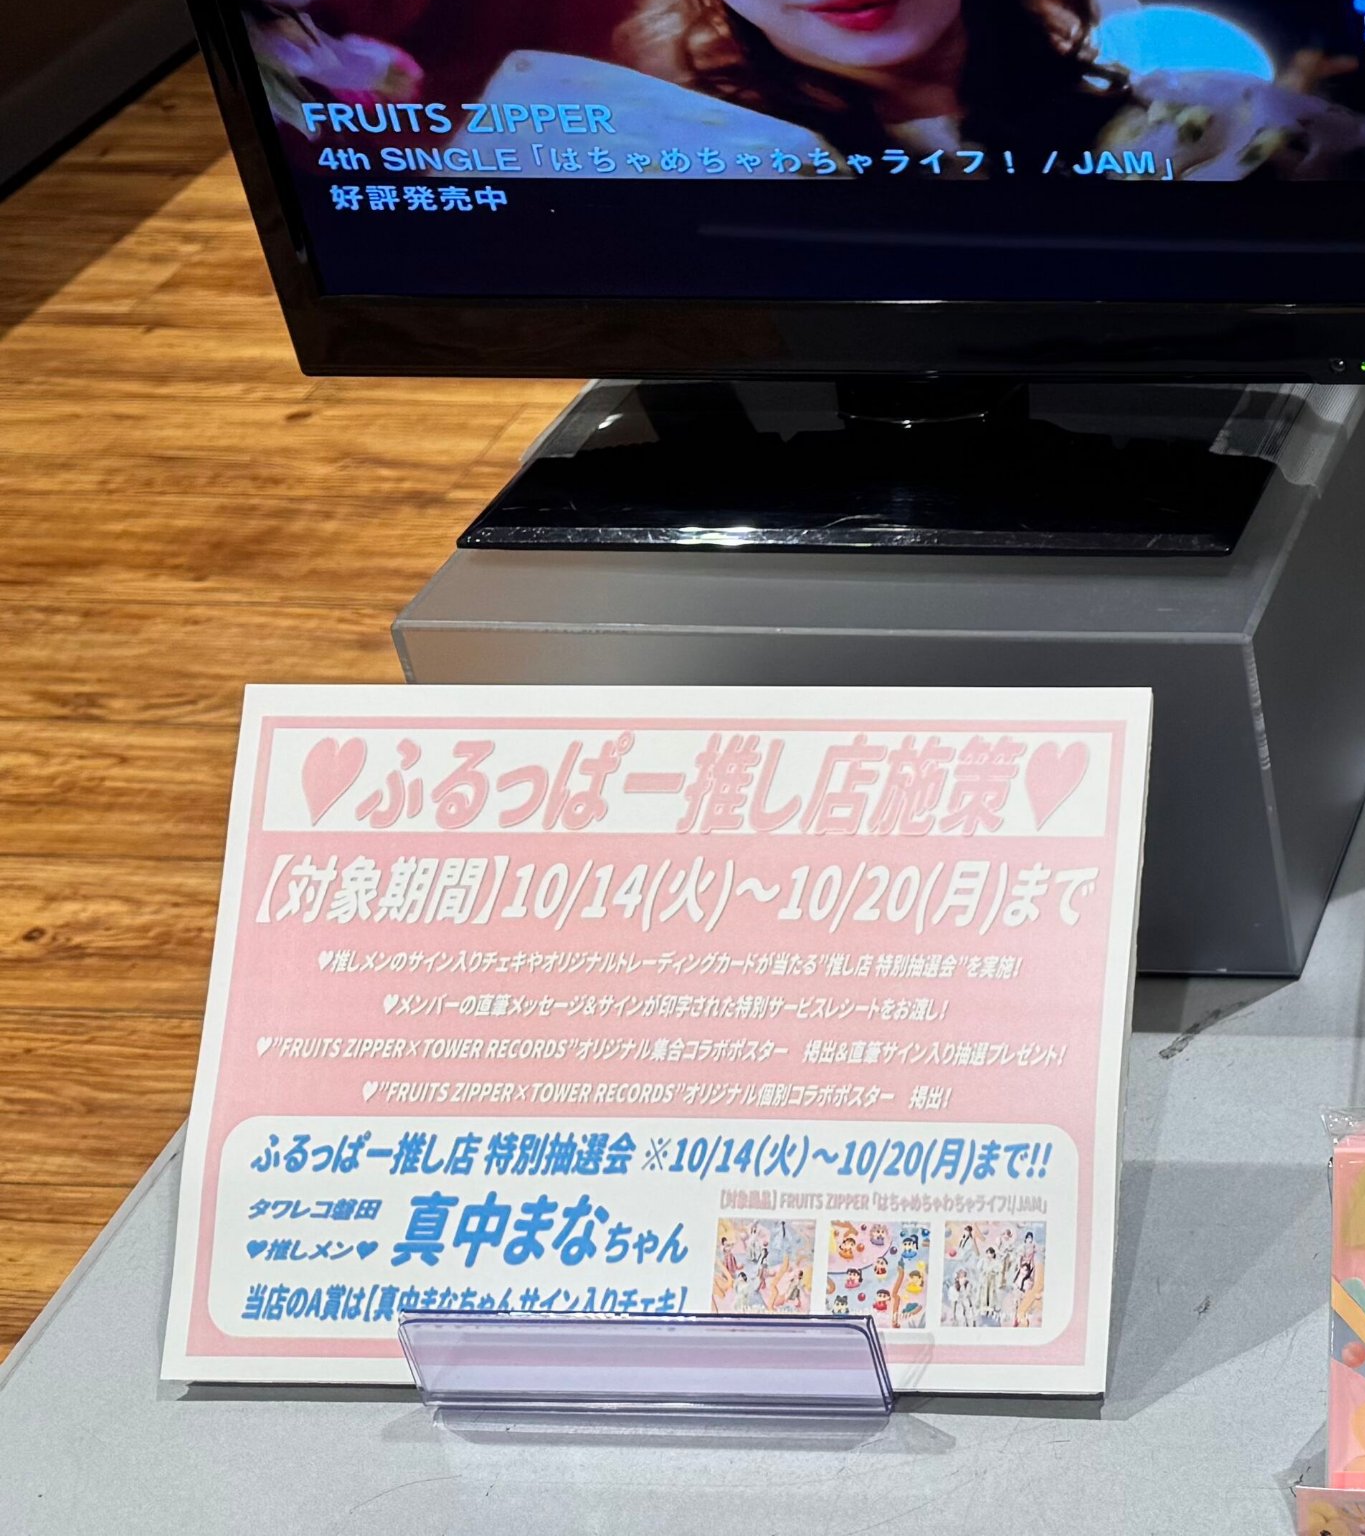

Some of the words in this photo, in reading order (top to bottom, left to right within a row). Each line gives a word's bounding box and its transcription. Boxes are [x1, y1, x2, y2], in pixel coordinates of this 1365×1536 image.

[301, 103, 451, 135] FRUITS
[463, 103, 617, 135] ZIPPER
[318, 146, 370, 172] 4th
[381, 148, 519, 173] SINGLE
[1073, 150, 1177, 183] JAM」
[329, 184, 508, 213] 好評発売中
[356, 731, 1022, 836] ふるっぱー推し店施策
[250, 1131, 477, 1177] ふるっぱー推し店
[483, 1131, 639, 1177] 特別抽選会
[248, 1198, 382, 1221] タワレコ磐田
[779, 1192, 824, 1210] FRUITS
[826, 1193, 870, 1210] ZIPPER
[390, 1191, 689, 1268] 真中まなちゃん
[265, 1240, 357, 1261] 推しメン
